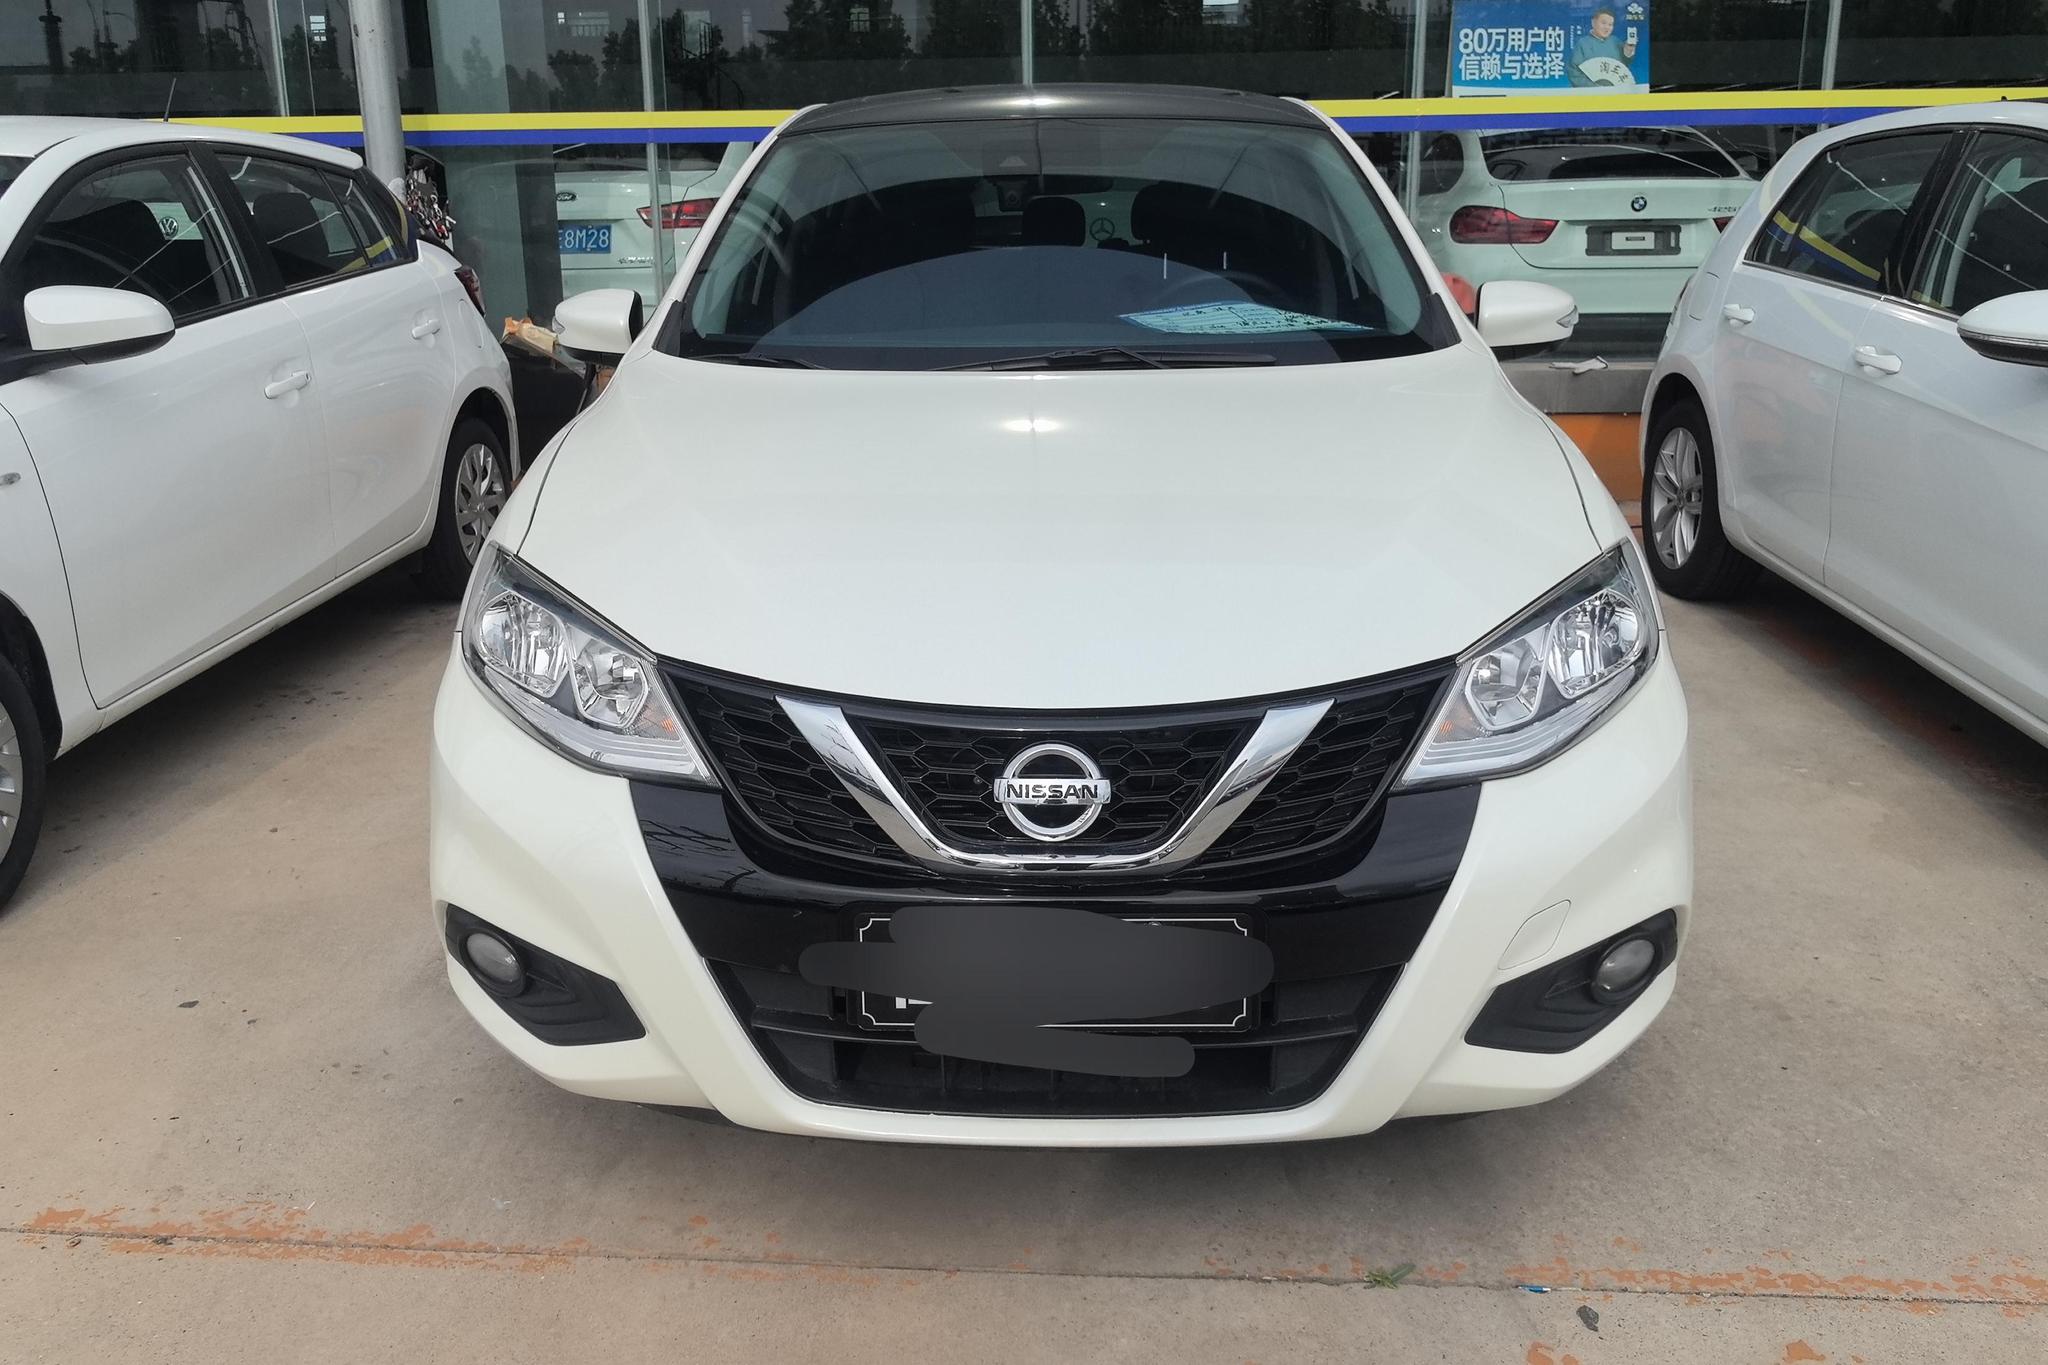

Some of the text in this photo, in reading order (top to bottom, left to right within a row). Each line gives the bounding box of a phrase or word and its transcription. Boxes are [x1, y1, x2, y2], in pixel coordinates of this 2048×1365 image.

[1459, 26, 1565, 54] 80万用户的
[1459, 52, 1565, 80] 信赖与选择
[1007, 784, 1098, 799] NISSAN
